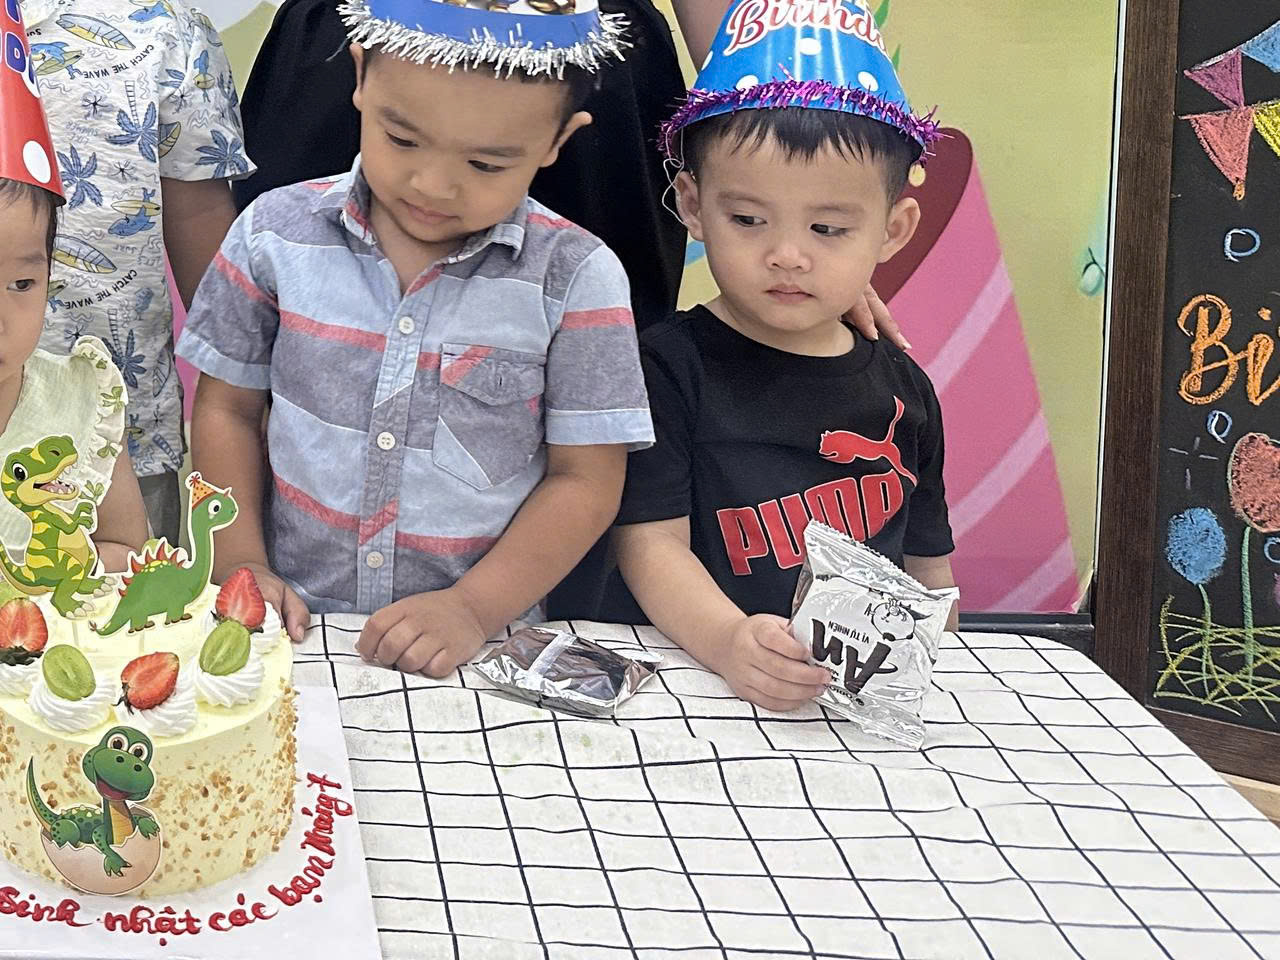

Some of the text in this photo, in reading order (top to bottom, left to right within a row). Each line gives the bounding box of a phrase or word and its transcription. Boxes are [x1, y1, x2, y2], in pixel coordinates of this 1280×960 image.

[84, 44, 154, 79] CATCH THE WAVE
[64, 269, 138, 310] CATCH THE WAVE
[717, 468, 904, 576] PUMA
[104, 905, 201, 946] nhật
[209, 893, 279, 931] các
